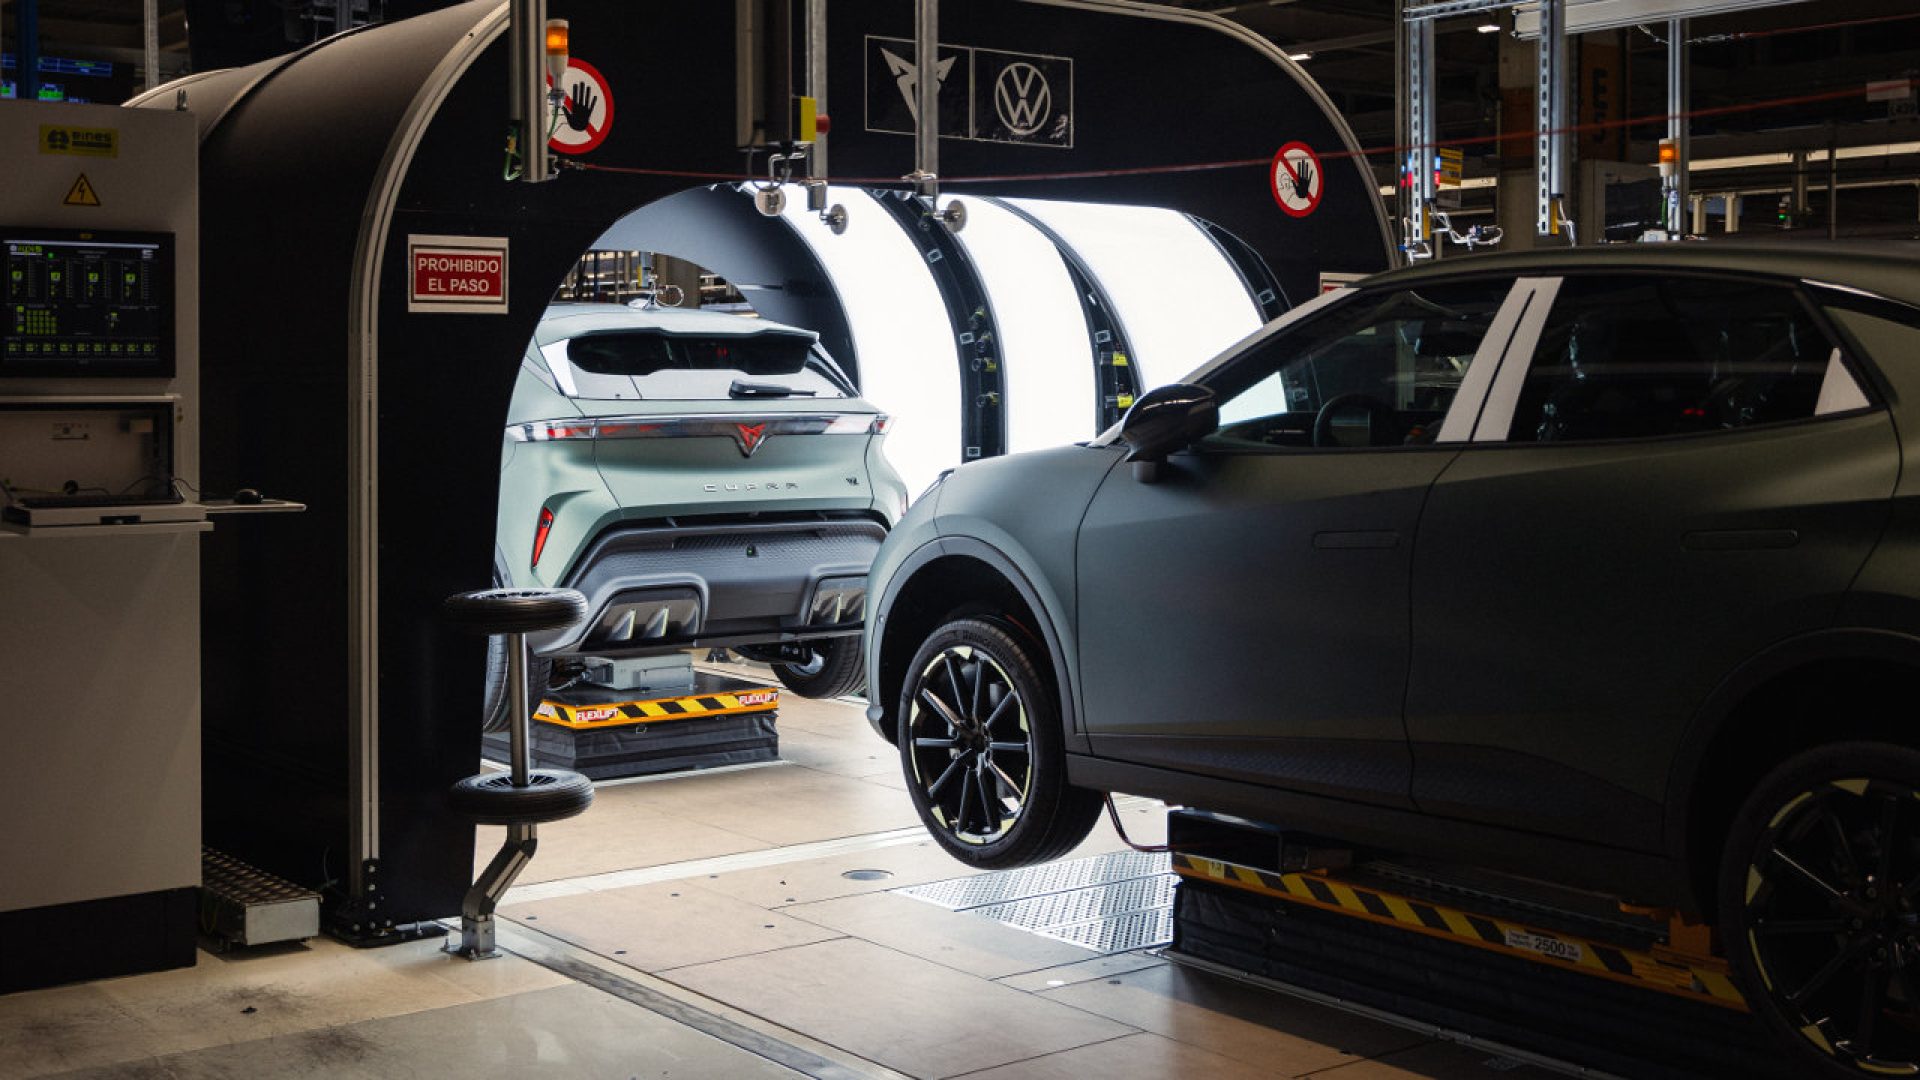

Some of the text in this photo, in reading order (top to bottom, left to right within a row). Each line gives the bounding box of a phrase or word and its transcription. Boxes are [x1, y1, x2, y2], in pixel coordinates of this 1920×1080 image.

[417, 257, 499, 273] PROHIBIDO
[428, 278, 489, 292] EL PASO
[703, 482, 799, 493] CUPRA
[739, 692, 778, 705] FLEXLIFT
[576, 707, 619, 721] FLEXLIFT
[1535, 935, 1565, 955] 2500
